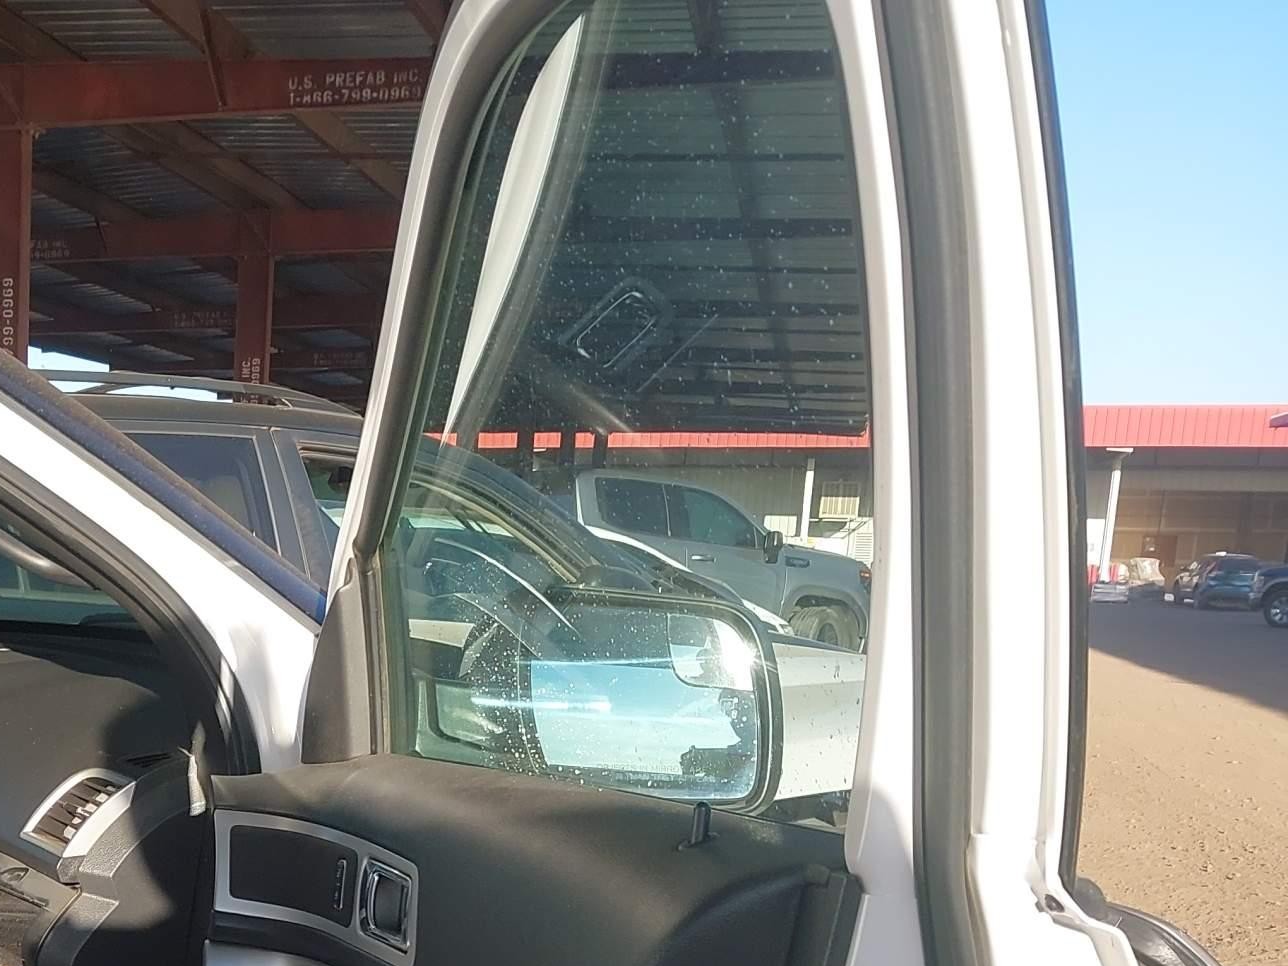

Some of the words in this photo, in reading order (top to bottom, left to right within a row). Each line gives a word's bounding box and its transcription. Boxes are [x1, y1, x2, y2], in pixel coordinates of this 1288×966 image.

[288, 75, 317, 91] U.S.
[325, 71, 385, 89] PREFAB
[2, 278, 14, 355] 99-0969
